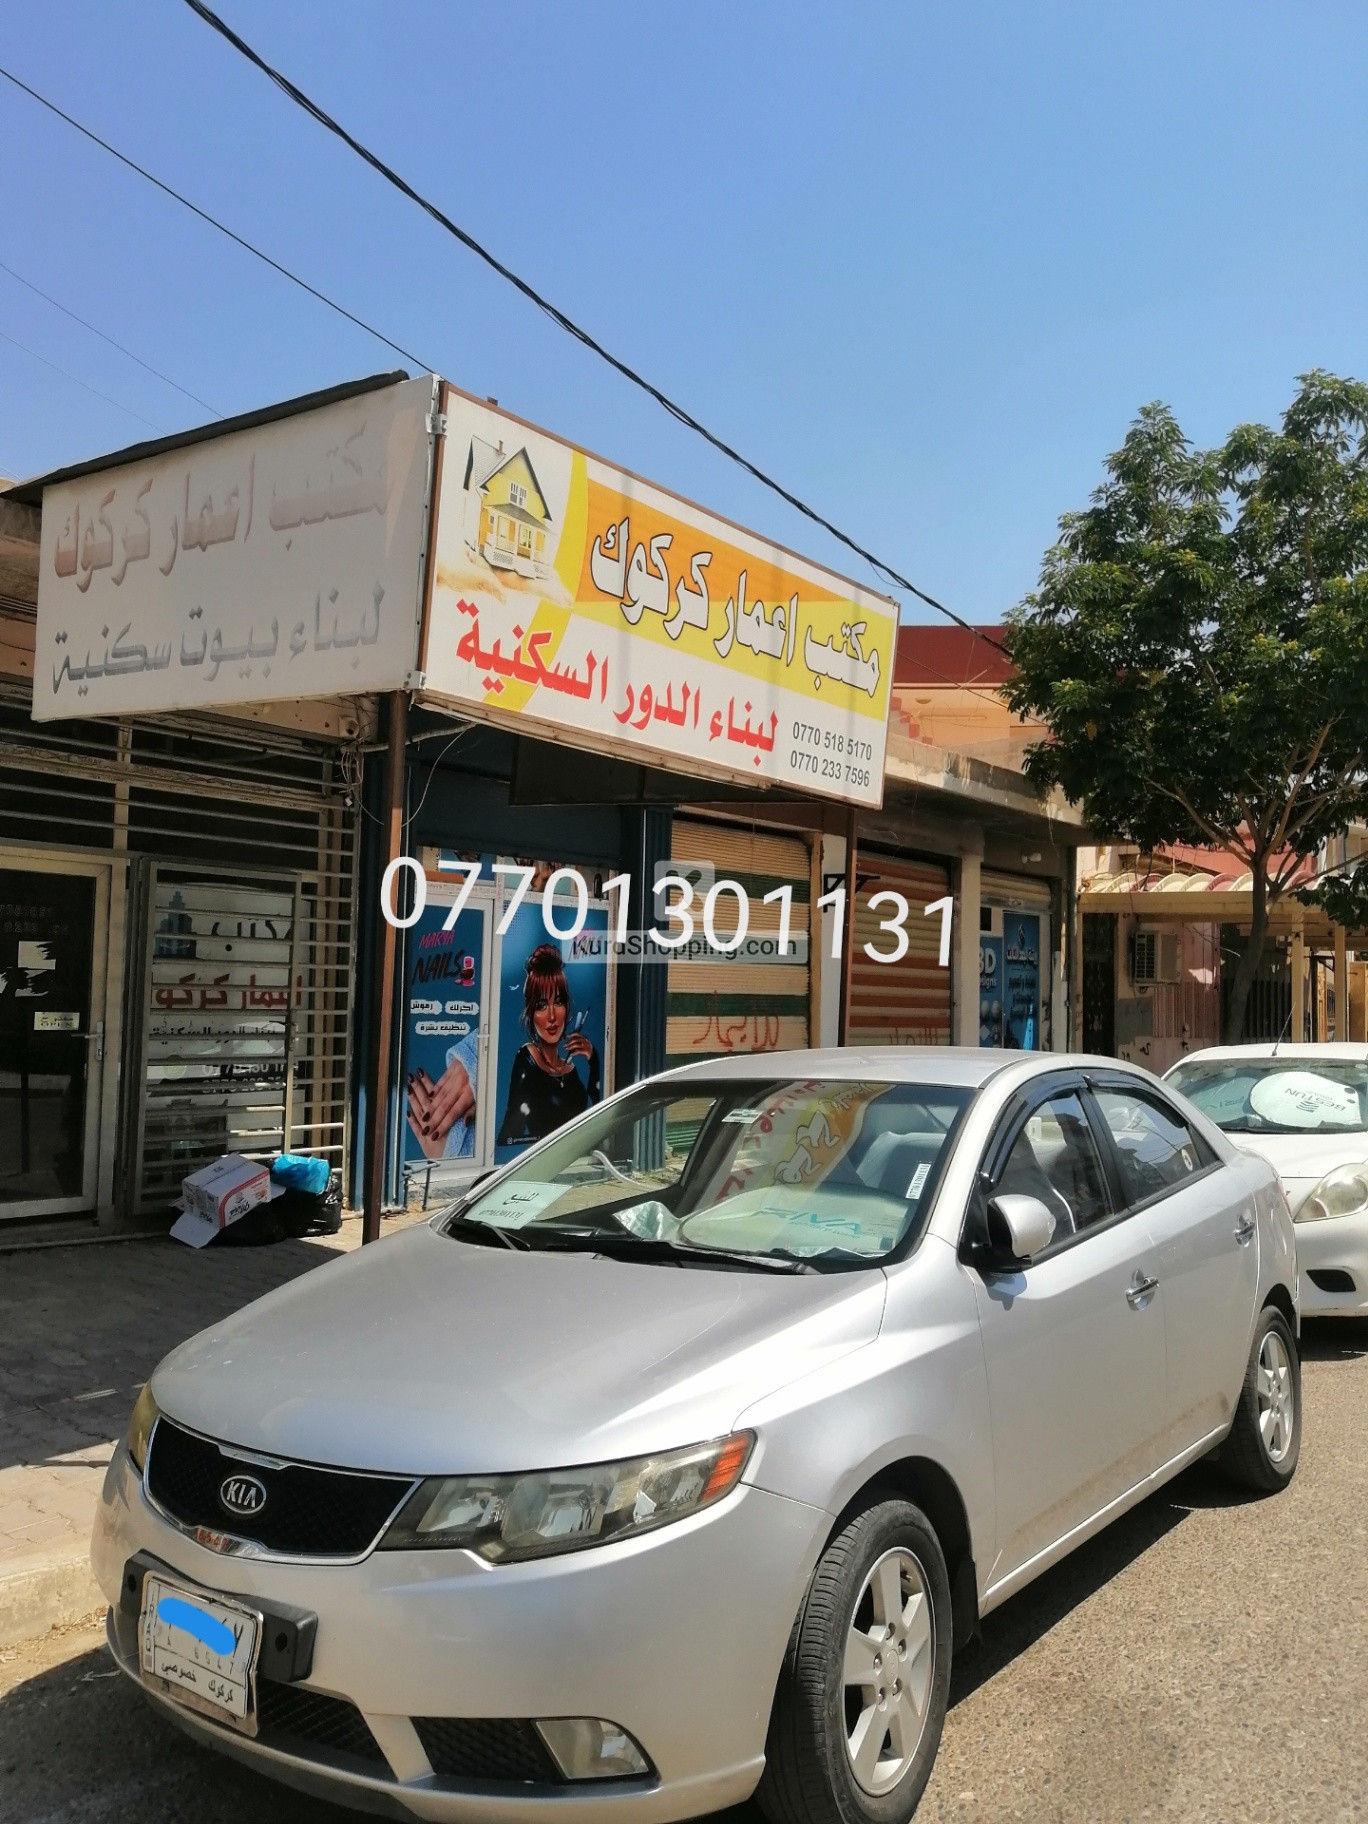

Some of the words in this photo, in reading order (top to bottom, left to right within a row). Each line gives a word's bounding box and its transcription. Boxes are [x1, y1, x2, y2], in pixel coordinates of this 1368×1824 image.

[54, 478, 155, 594] كركوك
[158, 454, 256, 577] اعمار
[590, 517, 713, 640] كركوك
[179, 606, 278, 682] بيوت
[288, 581, 386, 670] لبناء
[456, 598, 609, 703] السكنية
[713, 570, 799, 668] اعمار
[53, 621, 172, 697] سكنية
[803, 621, 881, 698] مكتب
[613, 680, 700, 730] الدور
[709, 696, 779, 767] لبناء
[792, 721, 821, 746] 0770
[824, 731, 843, 753] 518
[847, 738, 872, 761] 5170
[790, 750, 818, 773] 0770
[821, 758, 842, 782] 233
[845, 765, 870, 787] 7596
[412, 949, 465, 985] NAILS
[1284, 1087, 1347, 1112] BESTUN
[227, 1480, 257, 1509] KIA
[161, 1661, 198, 1683] خصوصي
[208, 1679, 234, 1704] كركوك
